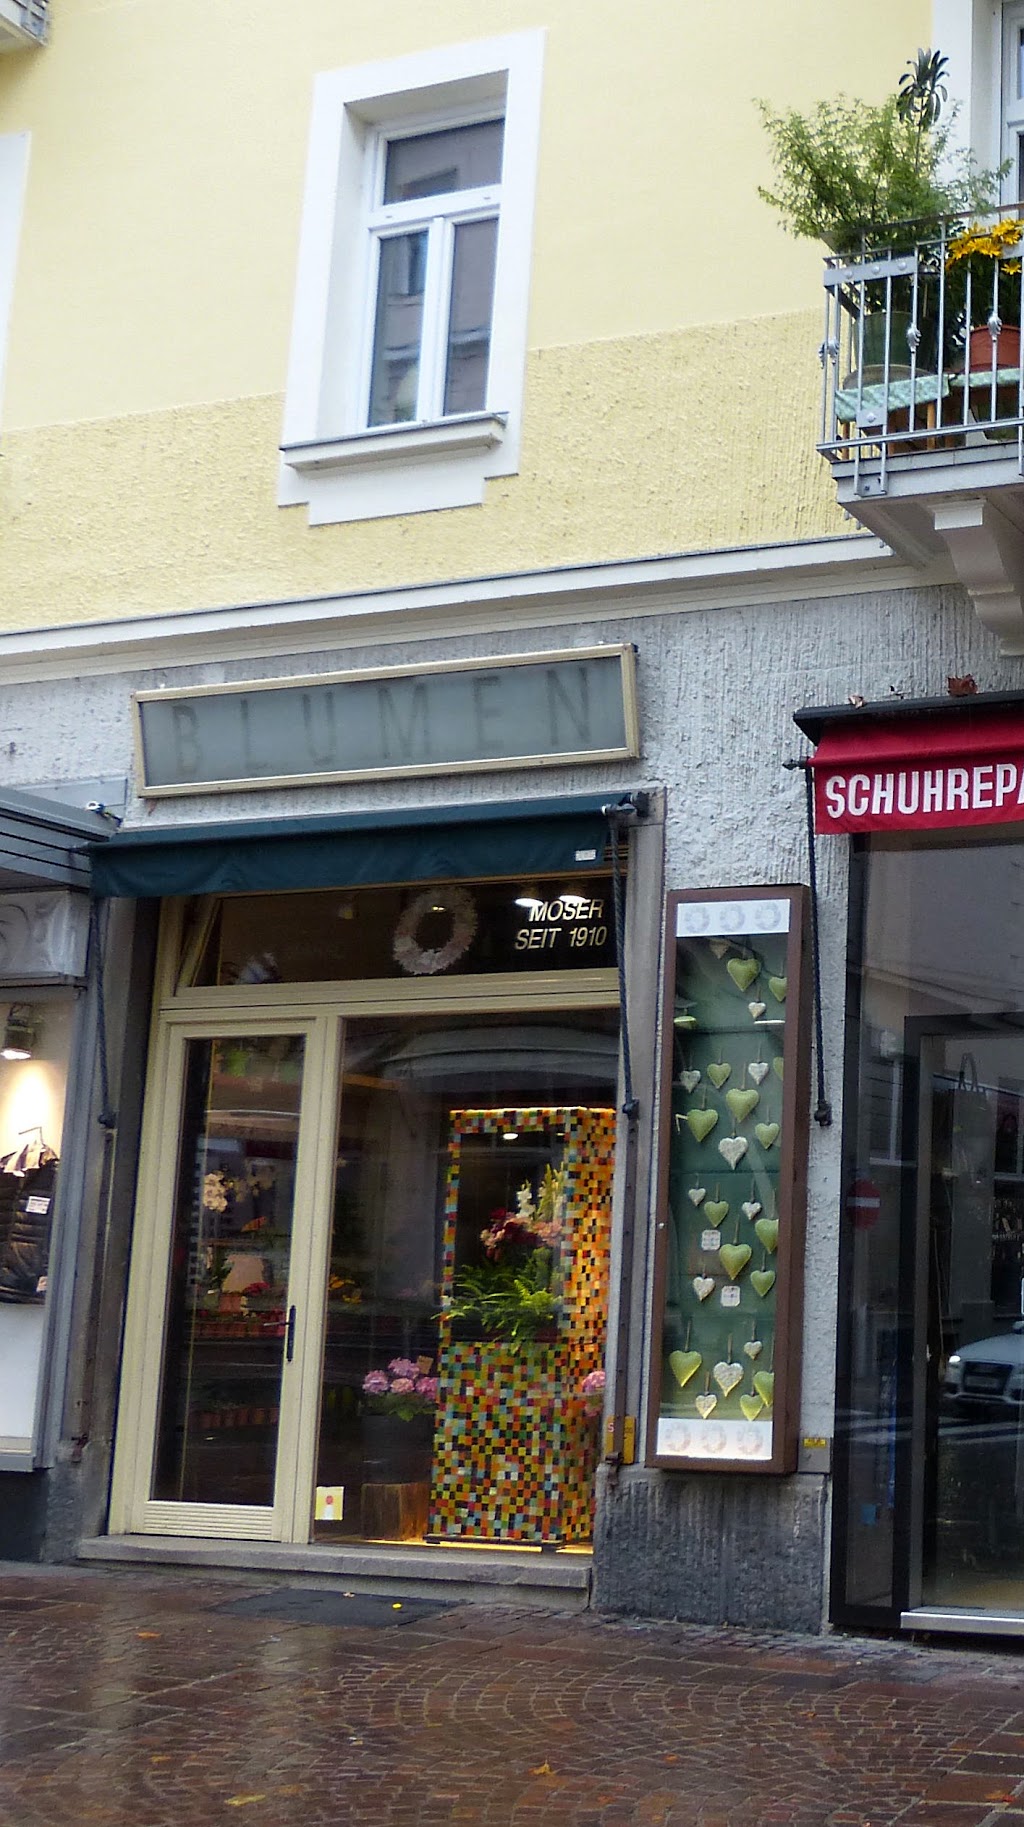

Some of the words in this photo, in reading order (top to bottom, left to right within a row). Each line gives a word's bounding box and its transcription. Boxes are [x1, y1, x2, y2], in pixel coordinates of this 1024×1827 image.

[171, 667, 591, 774] BLUMEN
[528, 899, 604, 922] MOSER
[515, 927, 562, 950] SEIT
[569, 926, 608, 947] 1910
